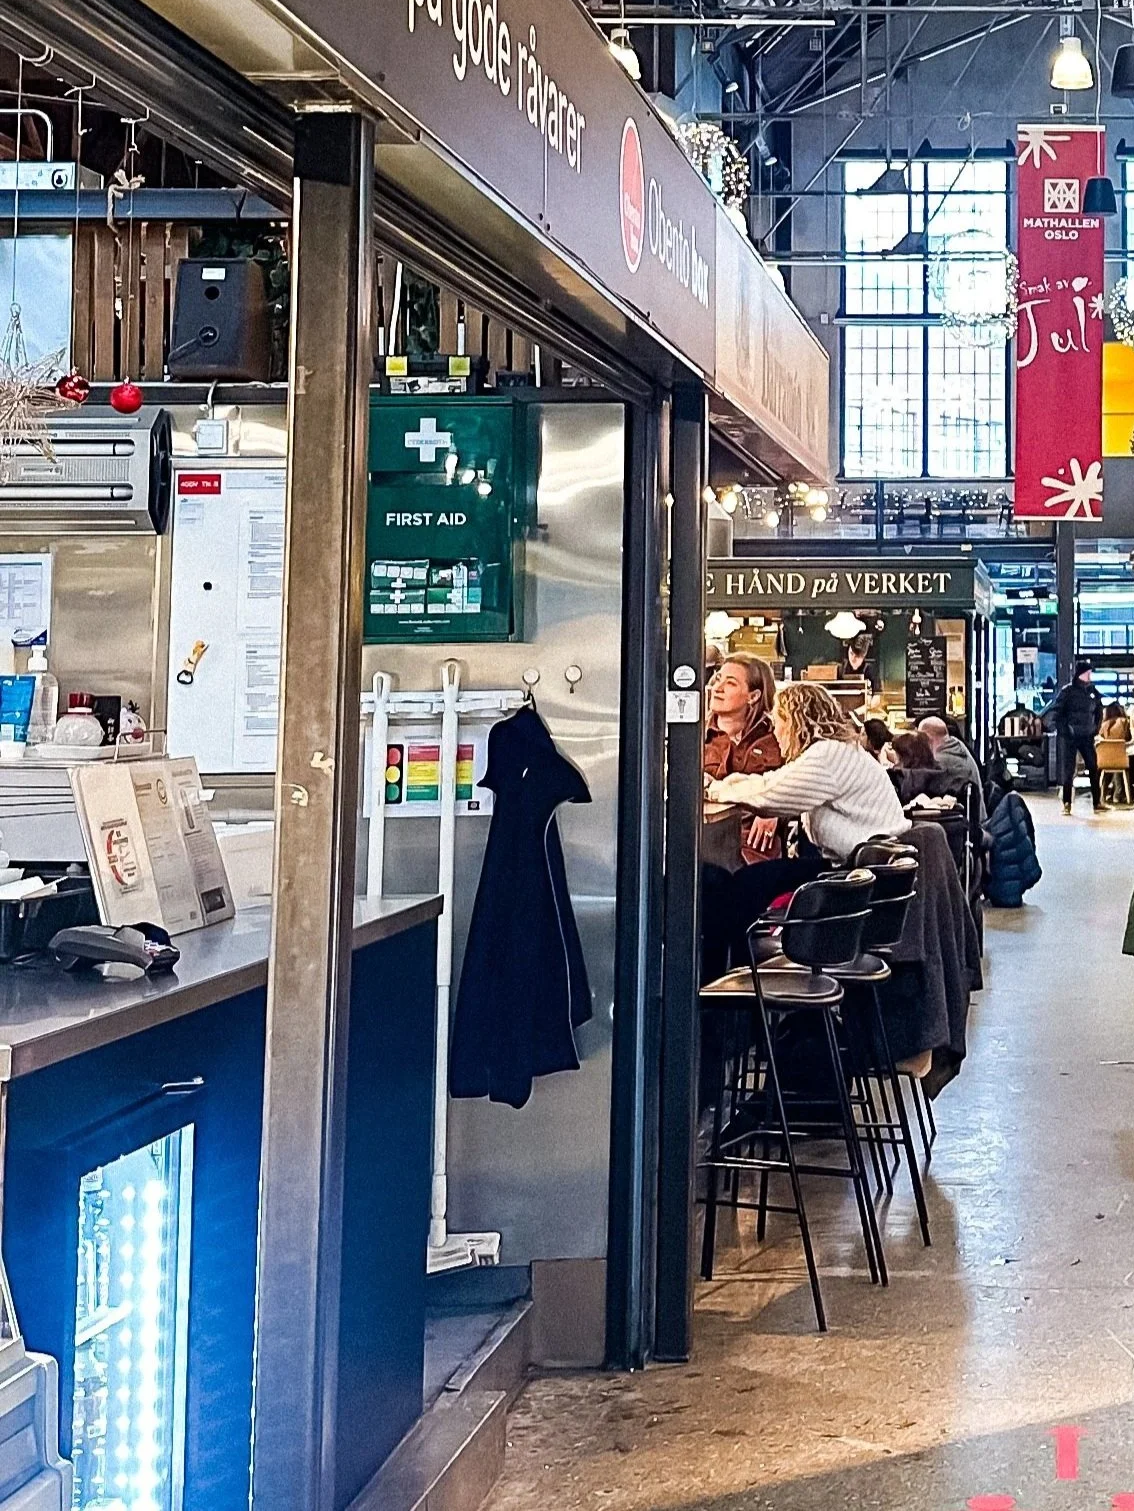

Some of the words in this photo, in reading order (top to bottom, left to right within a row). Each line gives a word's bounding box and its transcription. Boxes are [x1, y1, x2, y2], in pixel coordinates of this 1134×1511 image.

[517, 24, 586, 174] råvarer
[648, 177, 691, 289] Obento
[1023, 217, 1100, 229] MATHALLEN
[1044, 229, 1079, 240] OSLO
[1019, 276, 1051, 296] Smak
[1055, 279, 1070, 290] av
[1016, 295, 1091, 369] Jul
[385, 512, 433, 526] FIRST
[436, 512, 467, 526] AID
[726, 568, 806, 595] HÅND
[811, 572, 840, 598] på
[845, 572, 952, 594] VERKET
